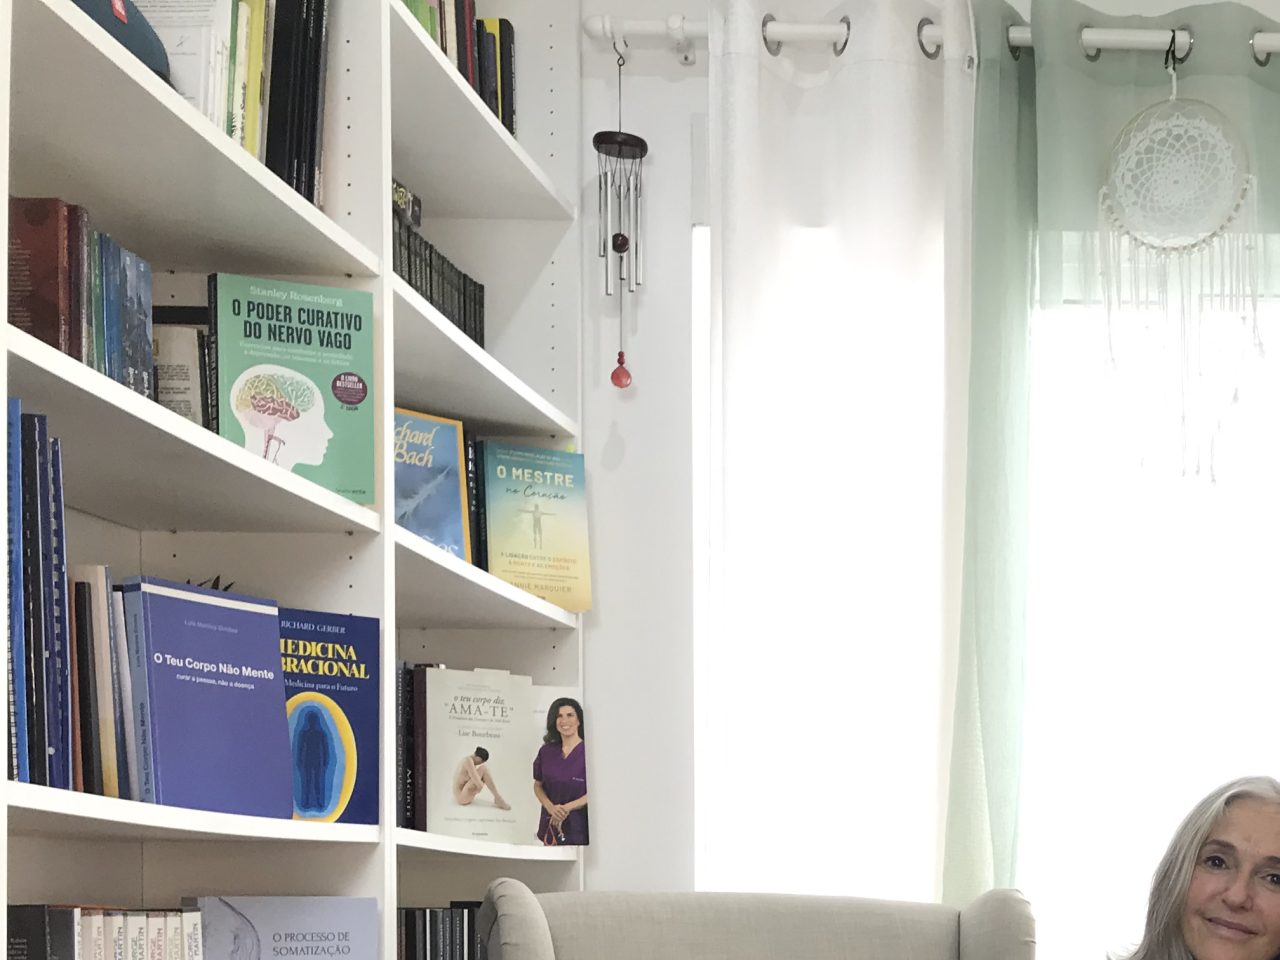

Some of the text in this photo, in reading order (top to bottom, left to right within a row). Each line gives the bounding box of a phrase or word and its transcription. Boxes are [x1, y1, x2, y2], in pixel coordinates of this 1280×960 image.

[250, 286, 343, 307] Stanley Rosenberg
[232, 299, 362, 332] O PODER CURATIVO
[244, 320, 352, 350] DO NERVO VAGO
[394, 422, 440, 447] chard
[394, 442, 435, 468] Bach
[496, 465, 574, 488] O MESTRE
[506, 487, 518, 495] no
[281, 620, 346, 634] RICHARD GERBER
[153, 652, 275, 681] O Teu Corpo Não Mente
[176, 674, 191, 682] curar
[196, 677, 217, 687] pessoa,
[218, 679, 228, 687] não
[234, 681, 255, 691] doença
[316, 683, 330, 691] para
[336, 683, 358, 692] Futuro
[460, 695, 472, 703] teu
[473, 697, 492, 706] corpo
[458, 729, 471, 737] Lise
[192, 922, 200, 956] MARTIN
[272, 931, 350, 943] O PROCESSO DE
[273, 945, 351, 957] SOMATIZAÇÃO
